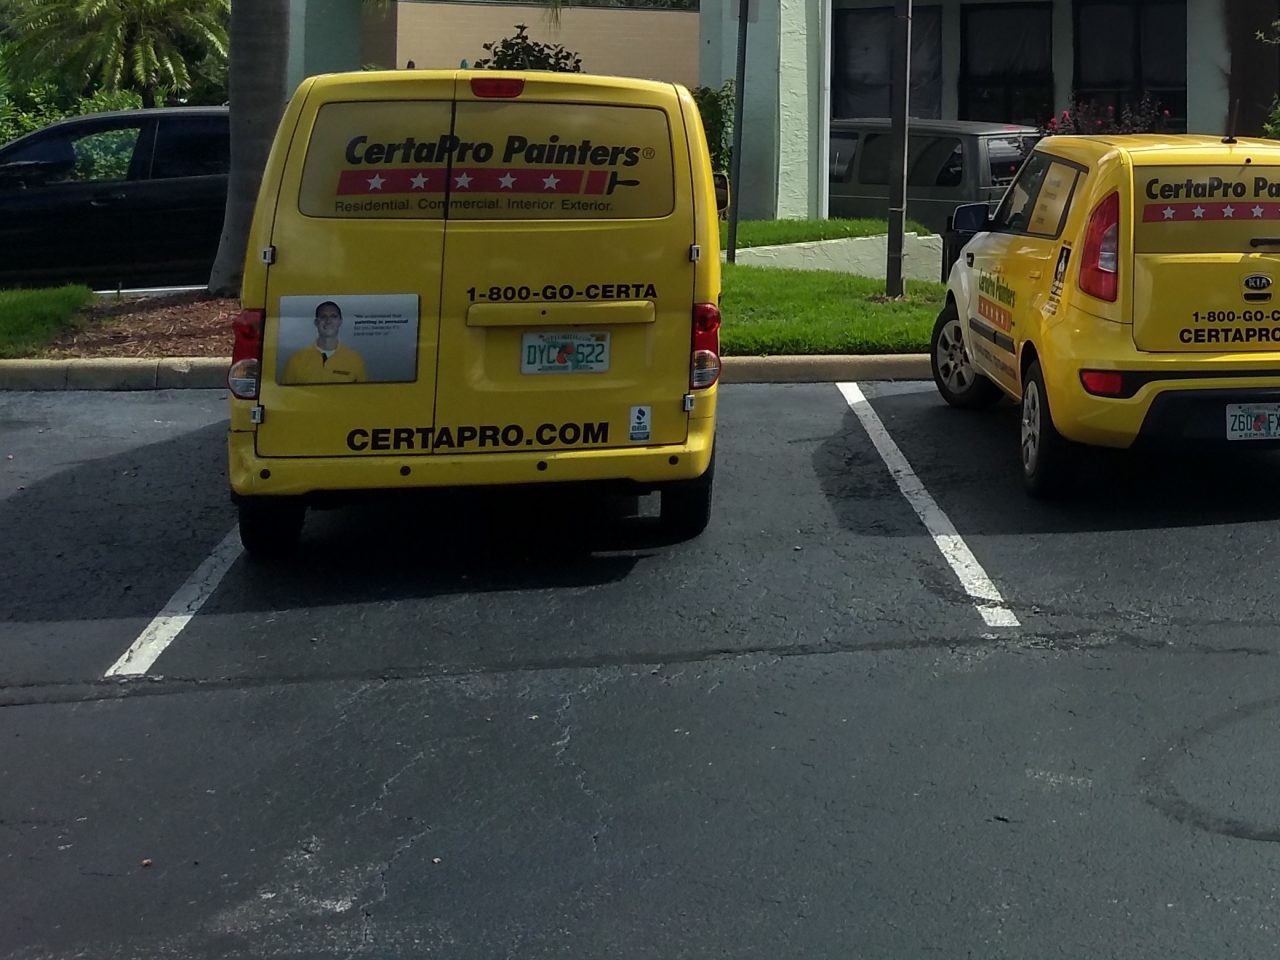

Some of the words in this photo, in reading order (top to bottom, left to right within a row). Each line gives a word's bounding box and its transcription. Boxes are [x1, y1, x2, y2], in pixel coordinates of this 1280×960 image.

[345, 134, 494, 165] CertaPro
[1145, 176, 1247, 200] CertaPro
[466, 284, 658, 302] 1-800-GO-CERTA
[1248, 277, 1268, 288] KIA
[1229, 414, 1252, 432] Z60
[347, 422, 609, 451] CERTAPRO.COM
